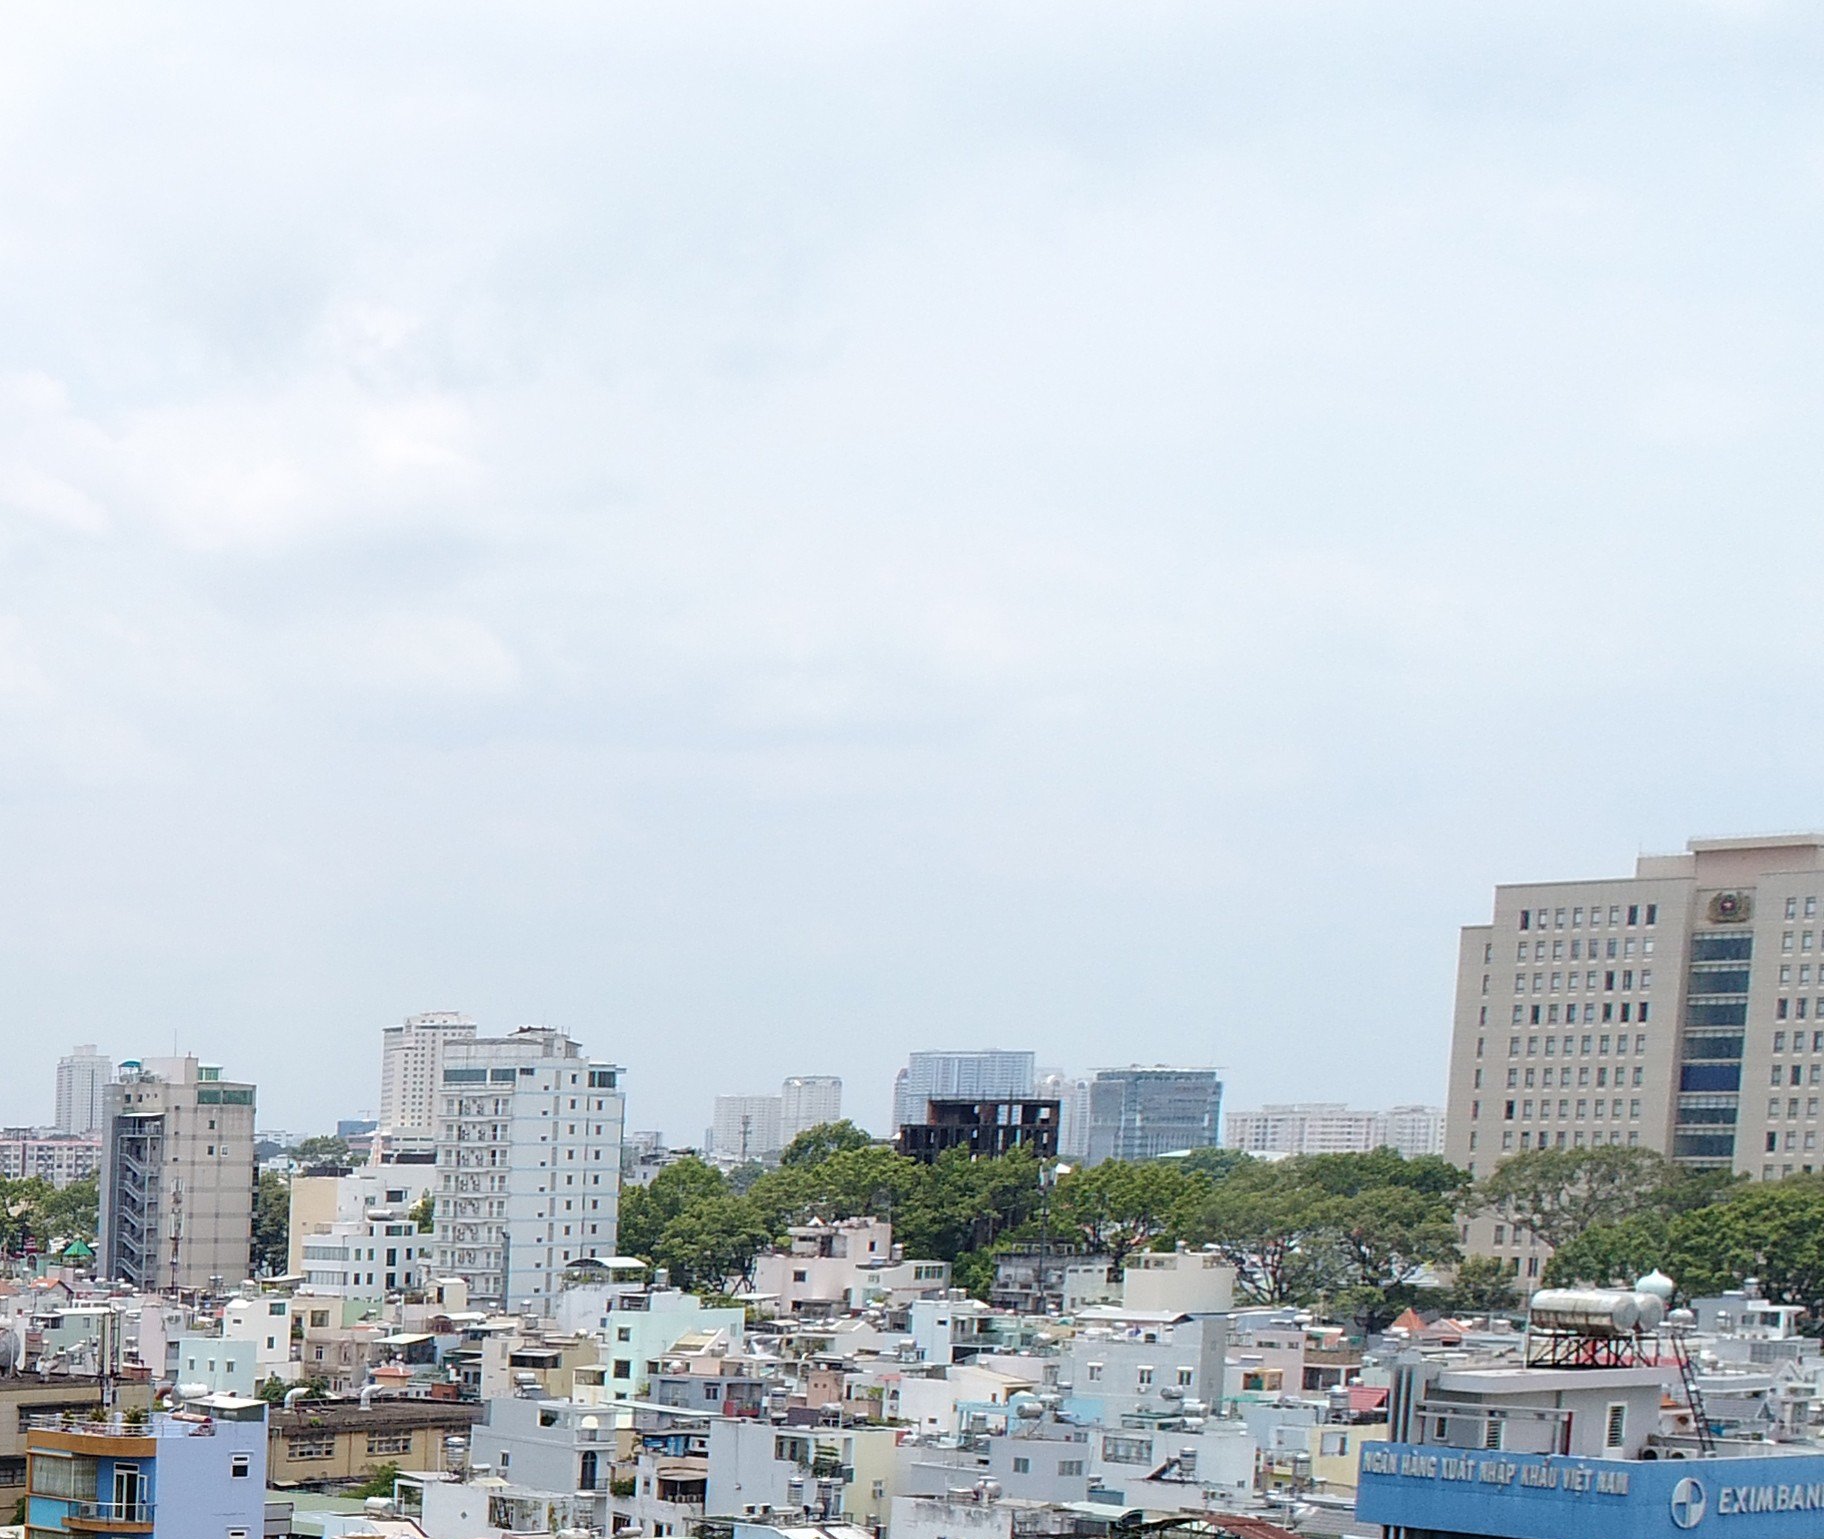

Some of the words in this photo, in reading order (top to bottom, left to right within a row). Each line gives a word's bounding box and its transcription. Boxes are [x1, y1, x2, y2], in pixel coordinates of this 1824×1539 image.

[1362, 1448, 1397, 1475] NGÂN
[1401, 1450, 1437, 1478] HÀNG
[1441, 1453, 1476, 1482] XUẤT
[1479, 1458, 1517, 1492] NHẬP
[1520, 1455, 1558, 1489] KHẨU
[1563, 1463, 1594, 1497] VIỆT
[1596, 1471, 1630, 1496] NAM
[1718, 1482, 1824, 1515] EXIMBAN
